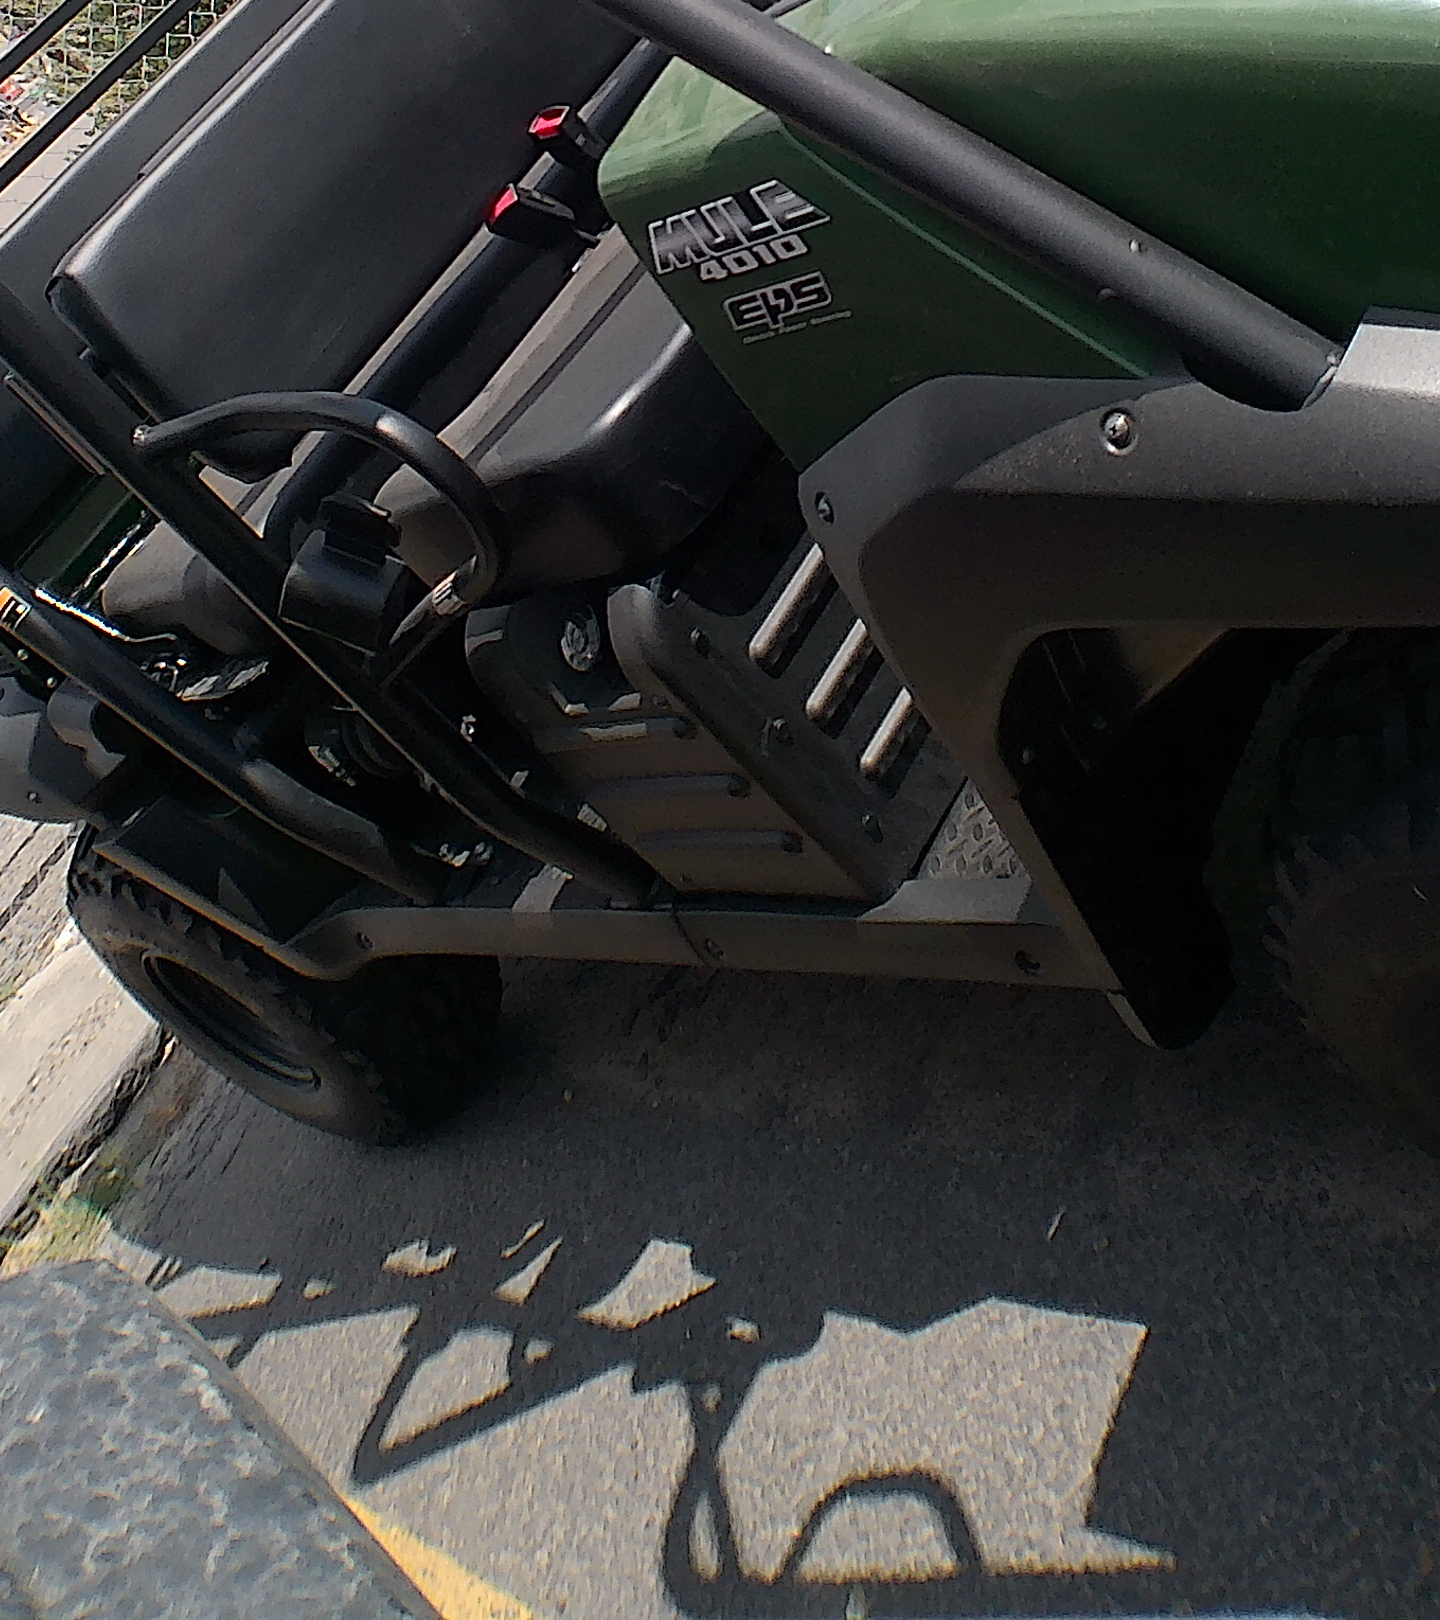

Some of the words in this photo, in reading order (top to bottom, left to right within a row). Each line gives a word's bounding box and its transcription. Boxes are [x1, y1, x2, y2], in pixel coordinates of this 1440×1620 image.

[647, 178, 831, 275] MULE
[698, 233, 810, 282] 4010
[722, 270, 833, 330] EPS
